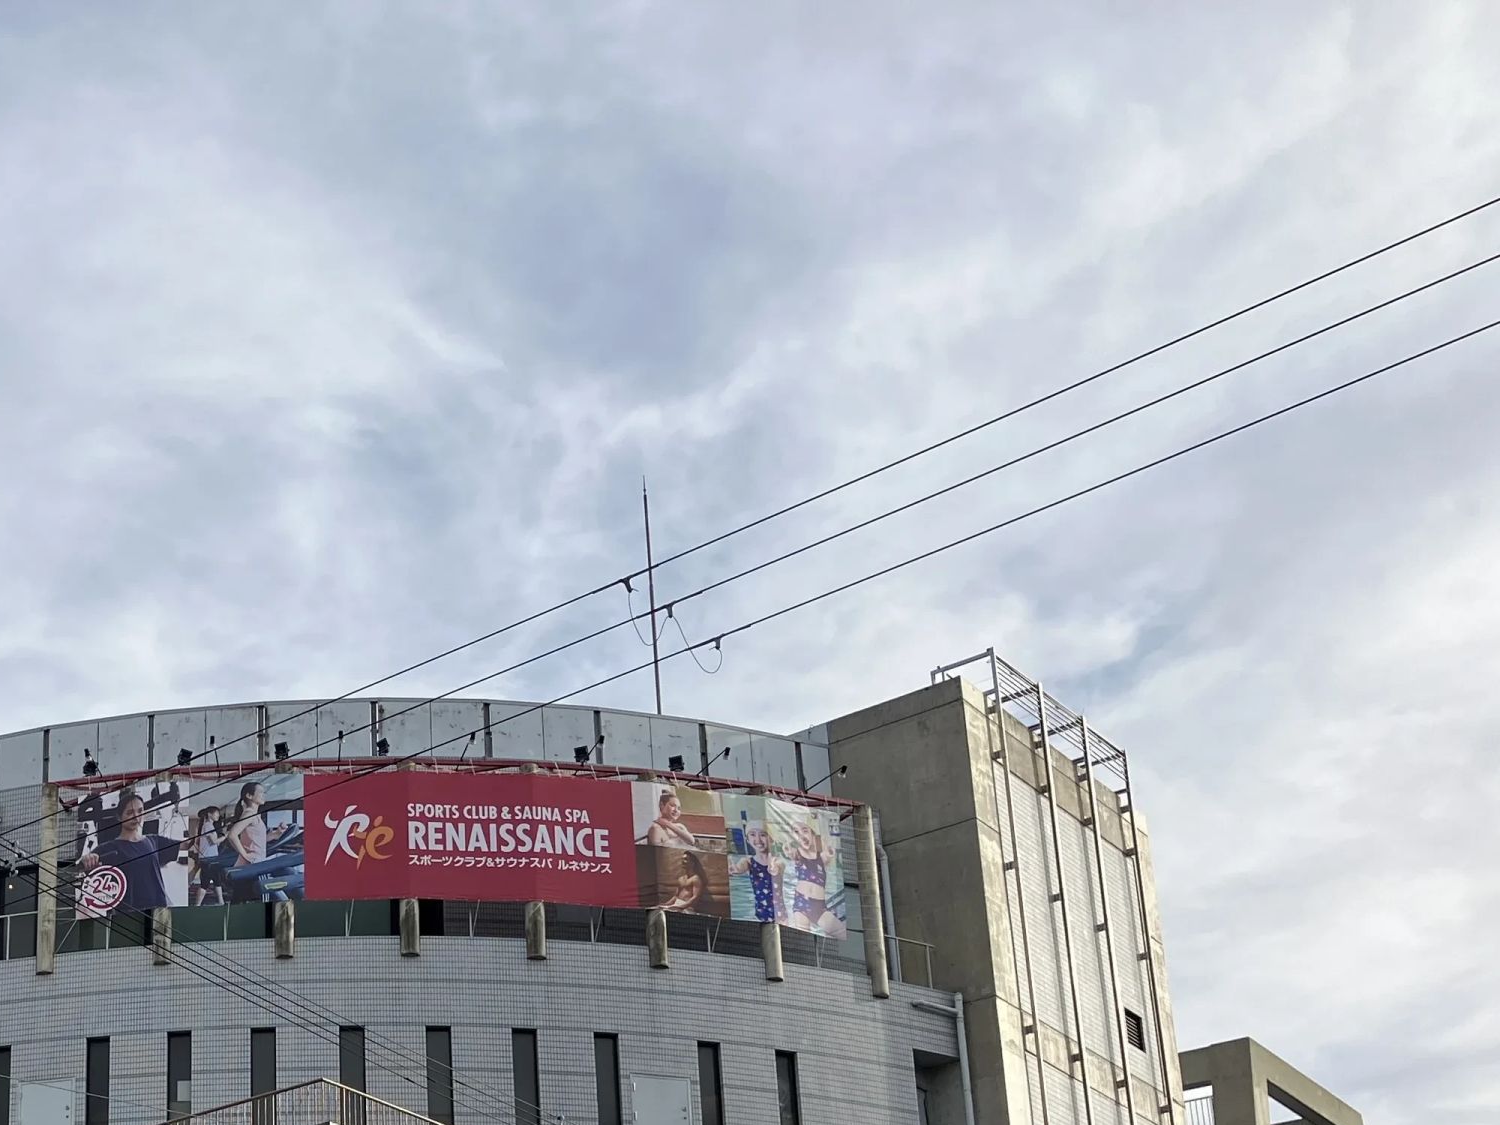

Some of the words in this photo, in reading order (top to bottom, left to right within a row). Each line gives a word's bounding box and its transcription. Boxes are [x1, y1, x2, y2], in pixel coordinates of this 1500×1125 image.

[407, 803, 460, 819] SPORTS
[463, 805, 498, 820] CLUB
[500, 806, 512, 820] &
[514, 806, 562, 822] SAUNA
[565, 808, 590, 824] SPA
[407, 820, 611, 858] RENAISSANCE
[408, 854, 553, 869] スポーツクラブ&サウナスパ
[557, 859, 612, 874] ルネサンス
